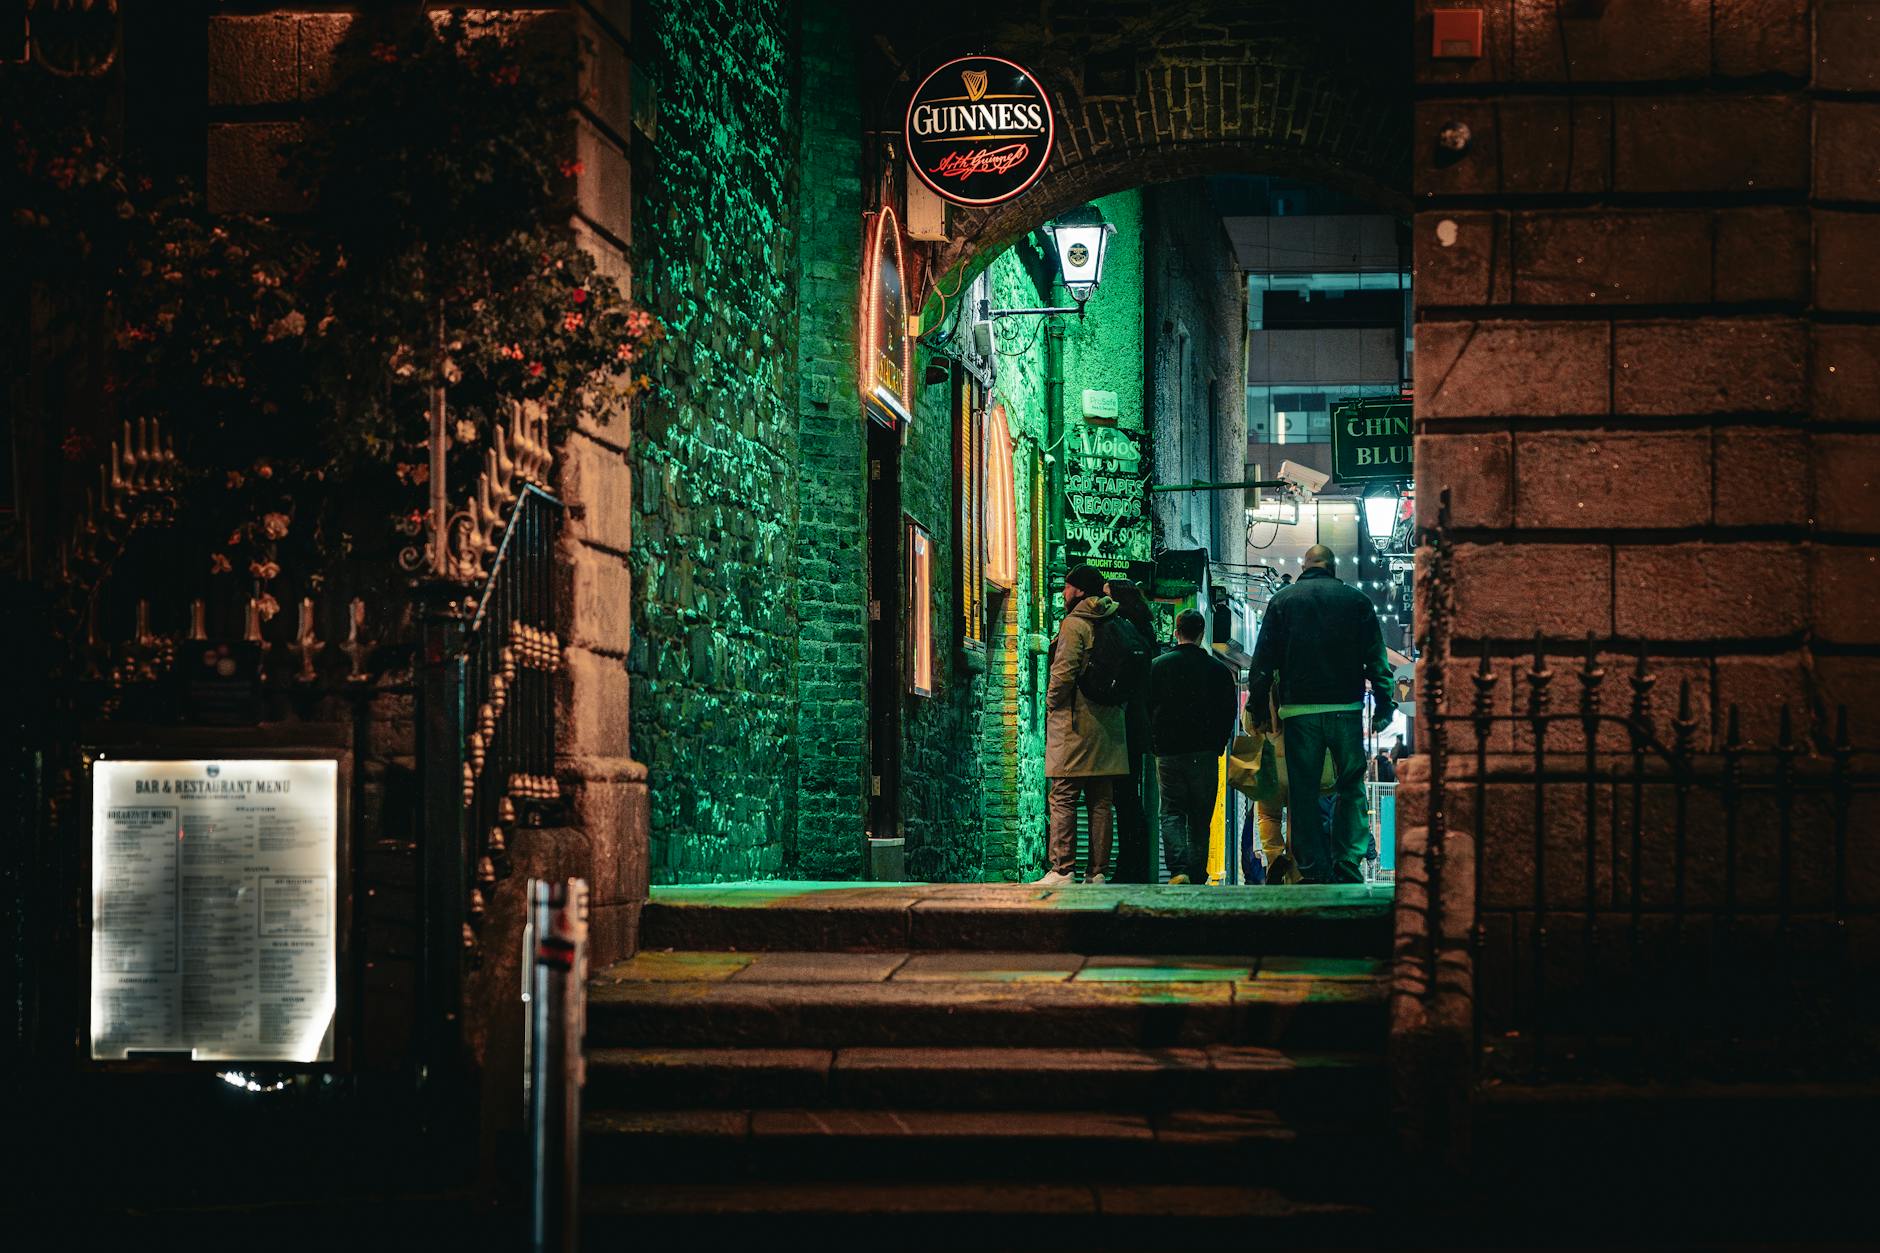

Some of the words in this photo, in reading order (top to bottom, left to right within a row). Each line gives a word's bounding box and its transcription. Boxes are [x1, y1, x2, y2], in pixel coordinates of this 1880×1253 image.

[913, 104, 1042, 135] GUINNESS
[1347, 417, 1413, 437] CHIN
[1096, 477, 1145, 499] TAPES
[1073, 494, 1142, 517] RECORDS
[1086, 558, 1113, 568] BOUGHT
[1113, 561, 1130, 569] SOLD
[135, 780, 160, 794] BAR
[175, 780, 252, 794] RESTAURANT
[255, 780, 291, 793] MENU
